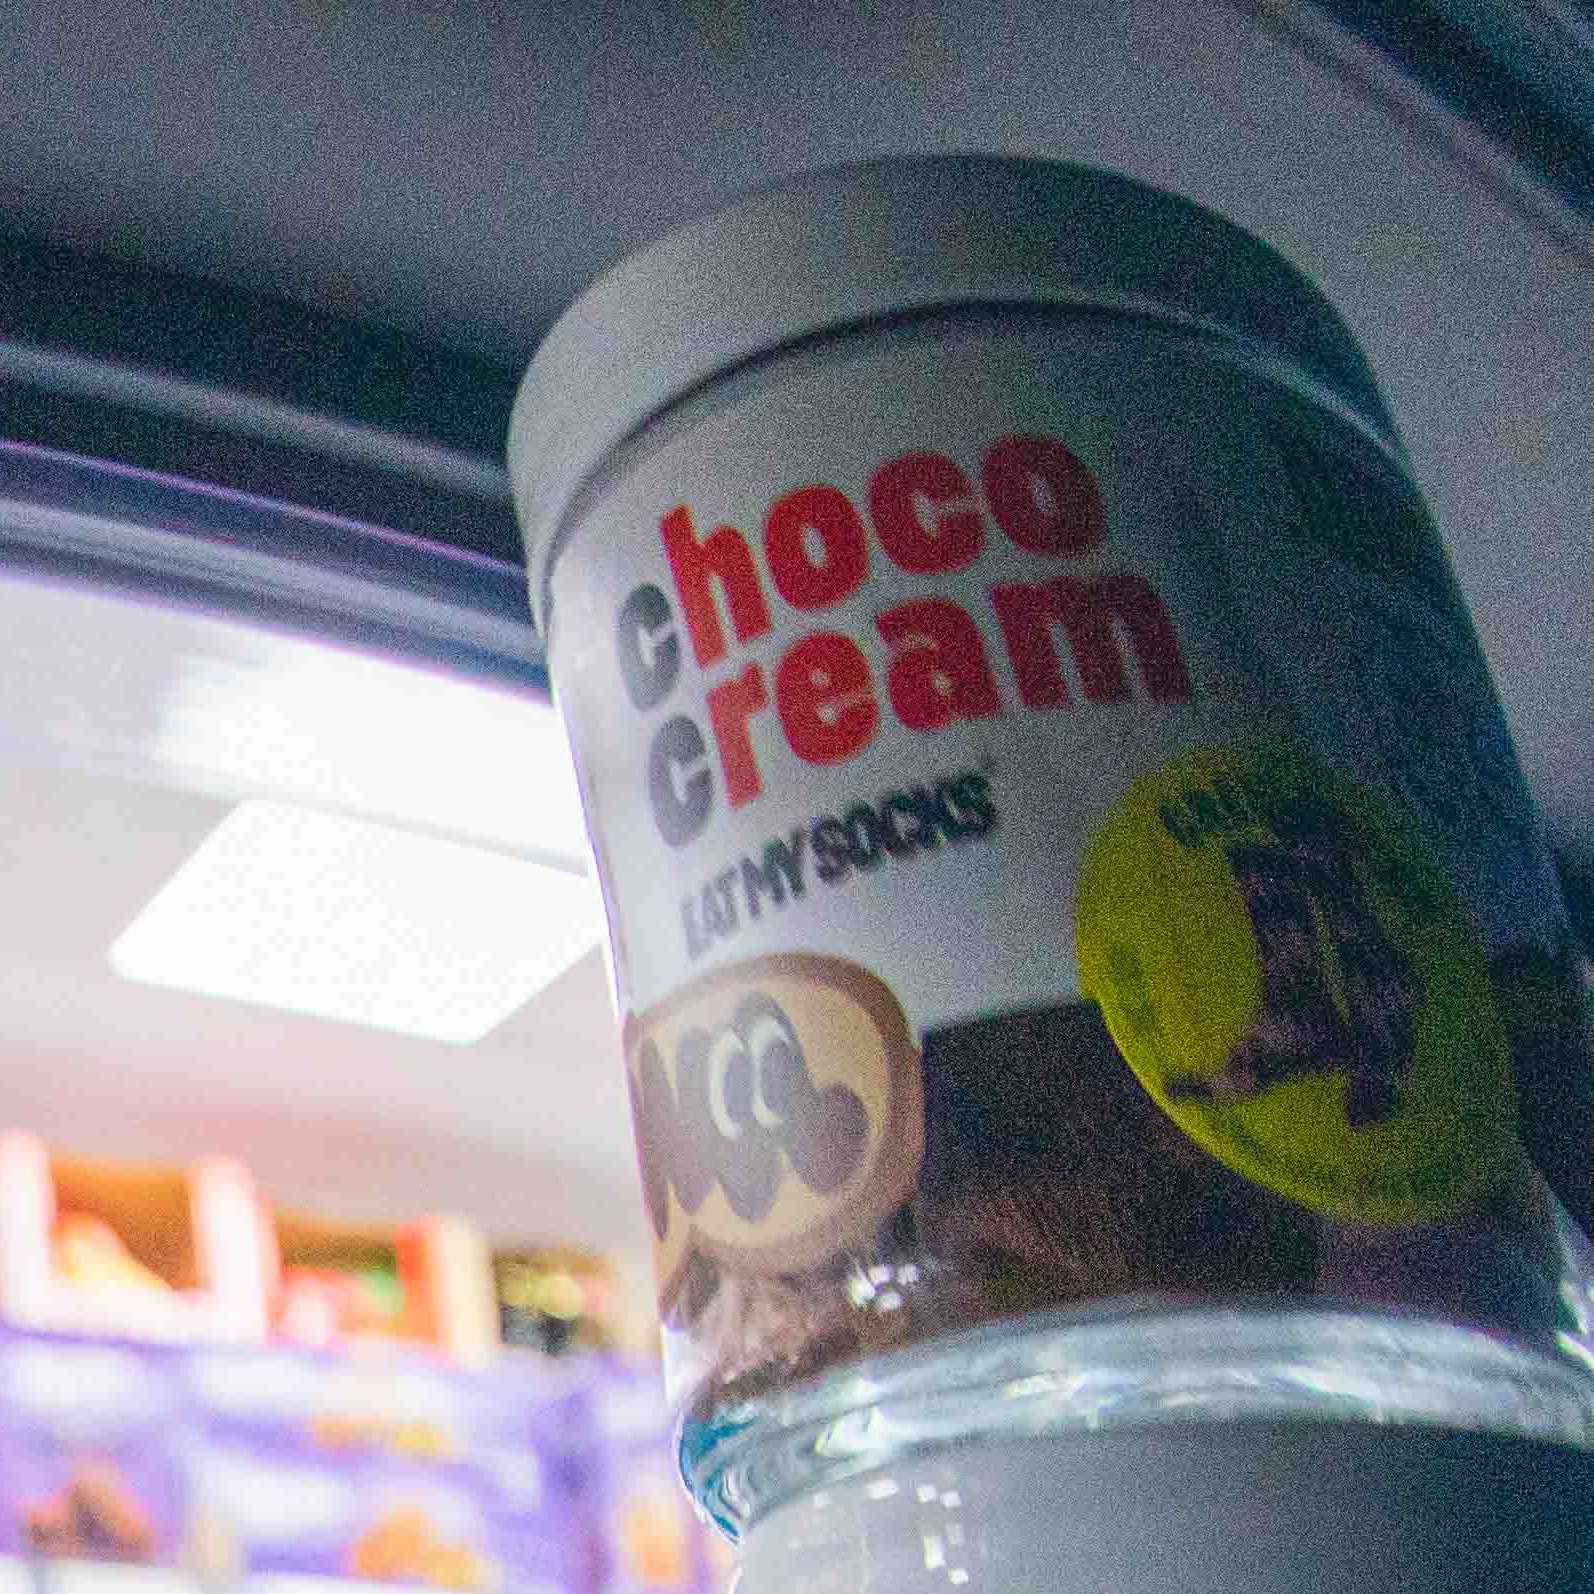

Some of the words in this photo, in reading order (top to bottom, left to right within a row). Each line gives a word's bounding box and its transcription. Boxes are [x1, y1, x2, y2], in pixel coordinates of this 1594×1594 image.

[617, 433, 1109, 711] choco
[647, 574, 1191, 848] cream
[741, 825, 810, 920] MY
[811, 771, 999, 886] SOCKS
